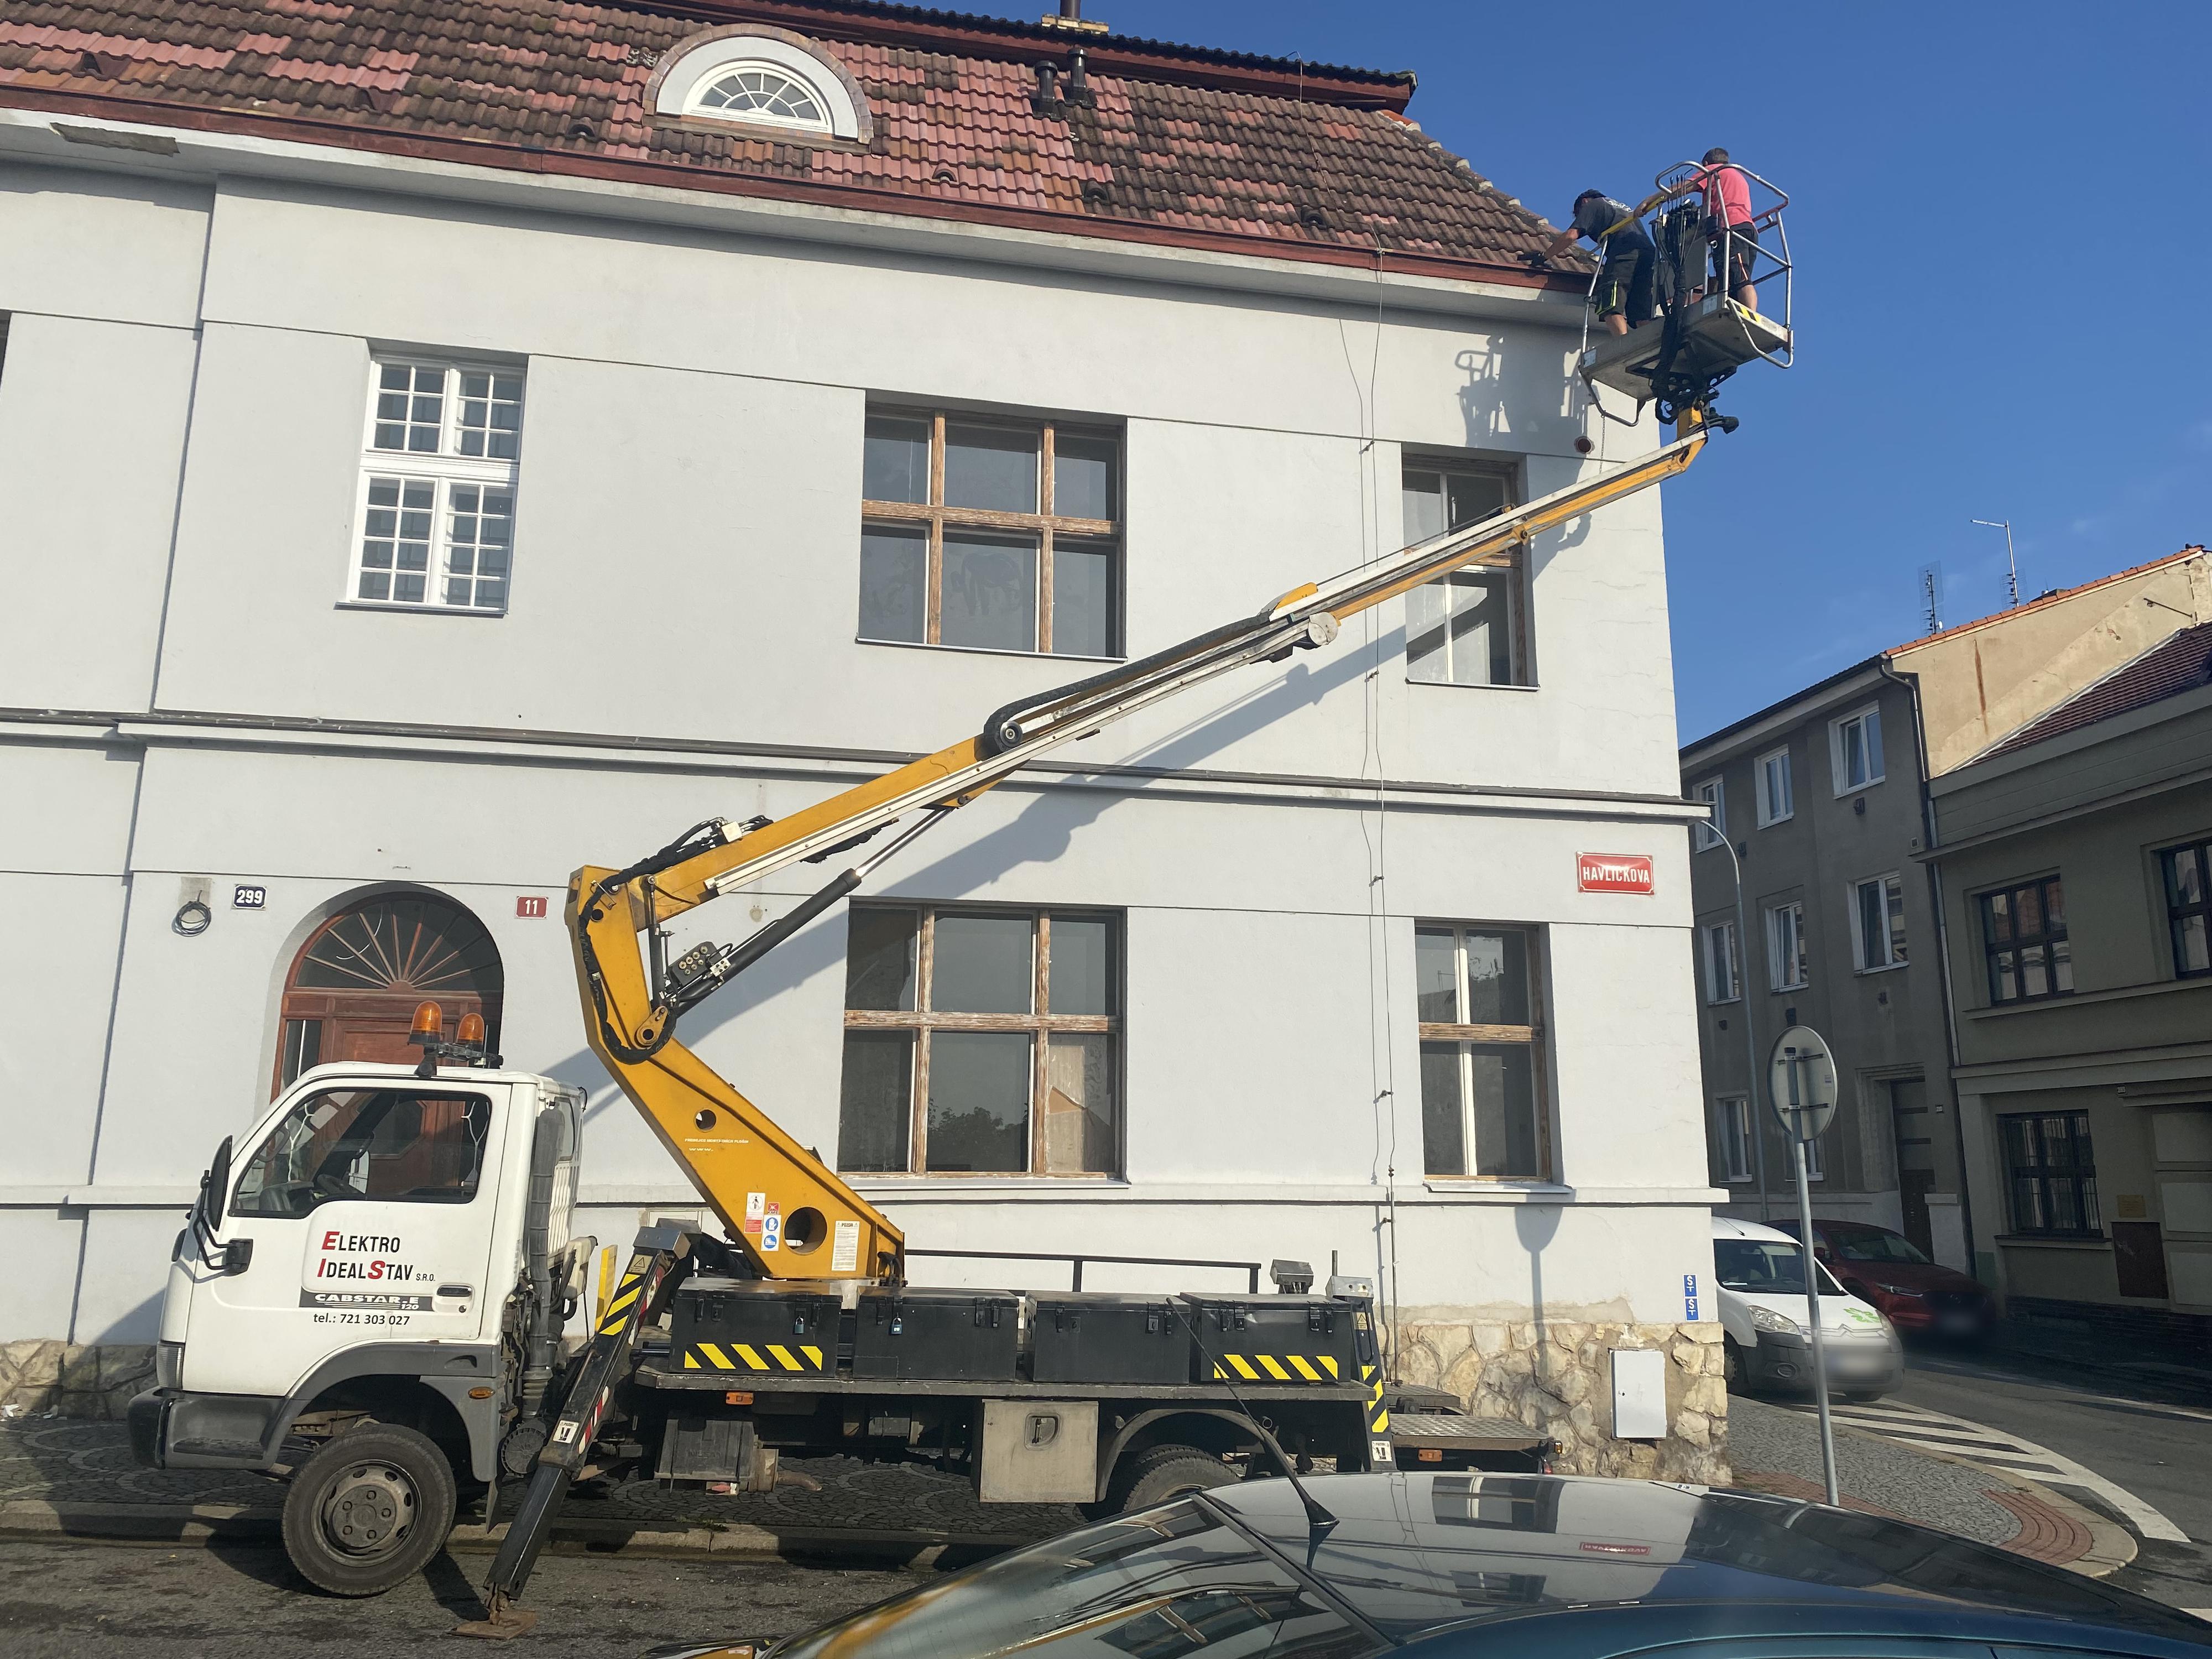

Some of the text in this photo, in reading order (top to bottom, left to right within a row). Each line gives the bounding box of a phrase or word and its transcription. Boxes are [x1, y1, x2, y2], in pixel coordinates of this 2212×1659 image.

[236, 889, 263, 904] 299
[525, 899, 538, 915] 11
[321, 1231, 400, 1253] ELEKTRO
[317, 1258, 436, 1282] IDEALSTAV S.R.O.
[314, 1313, 410, 1326] tel.: 721 303 027
